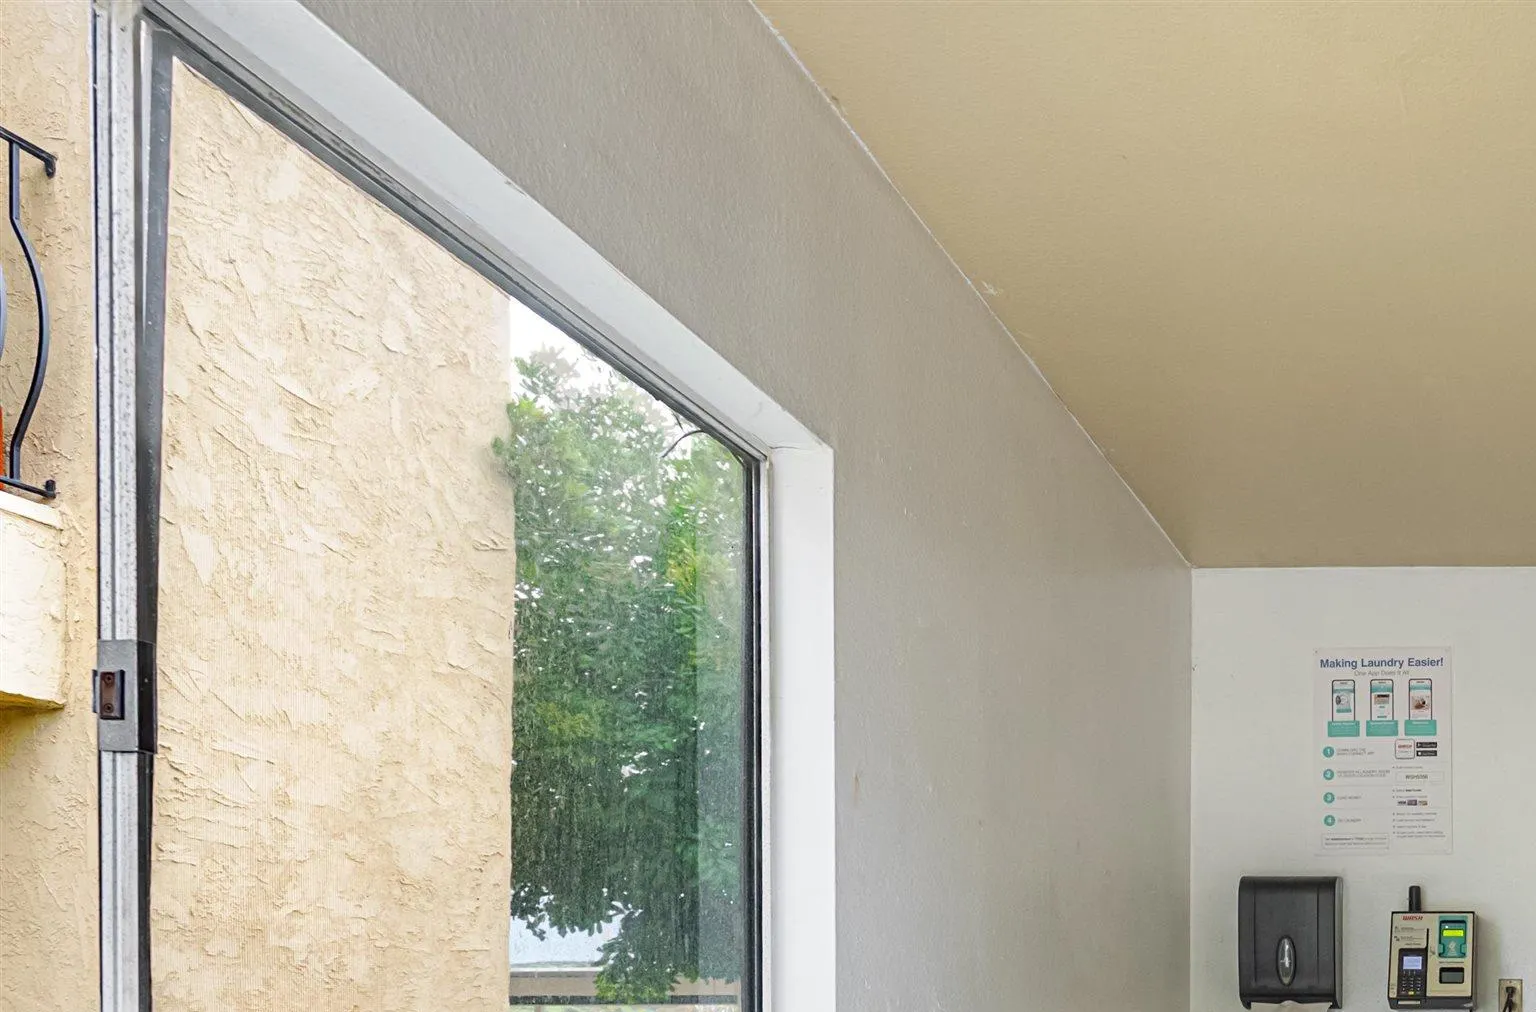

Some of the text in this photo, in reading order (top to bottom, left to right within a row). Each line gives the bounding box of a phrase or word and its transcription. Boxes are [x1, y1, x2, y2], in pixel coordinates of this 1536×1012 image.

[1320, 657, 1444, 670] Making Laundry Easier!
